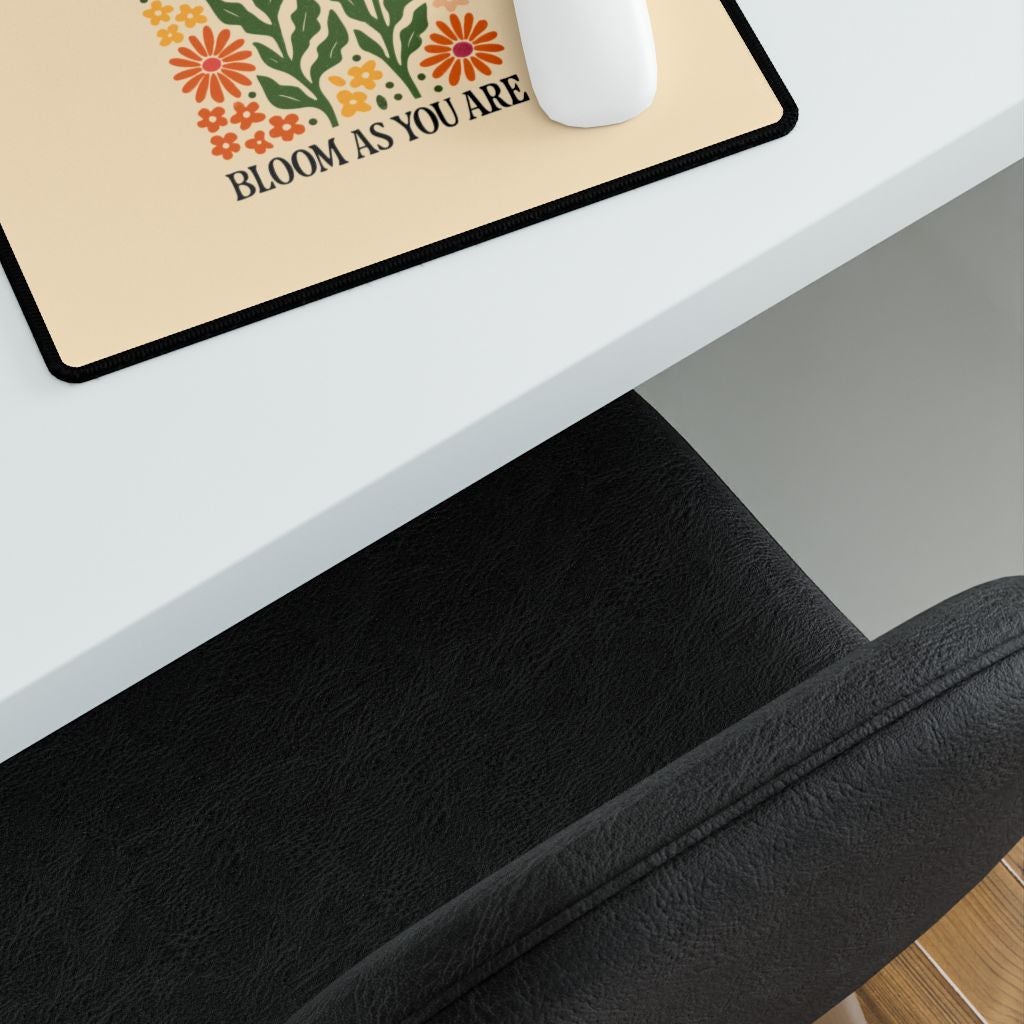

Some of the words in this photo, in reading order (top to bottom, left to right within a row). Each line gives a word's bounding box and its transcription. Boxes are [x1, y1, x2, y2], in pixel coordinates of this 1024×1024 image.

[226, 137, 348, 201] BLOOM
[351, 123, 394, 160] AS
[392, 97, 460, 143] YOU
[465, 74, 531, 121] ARE
